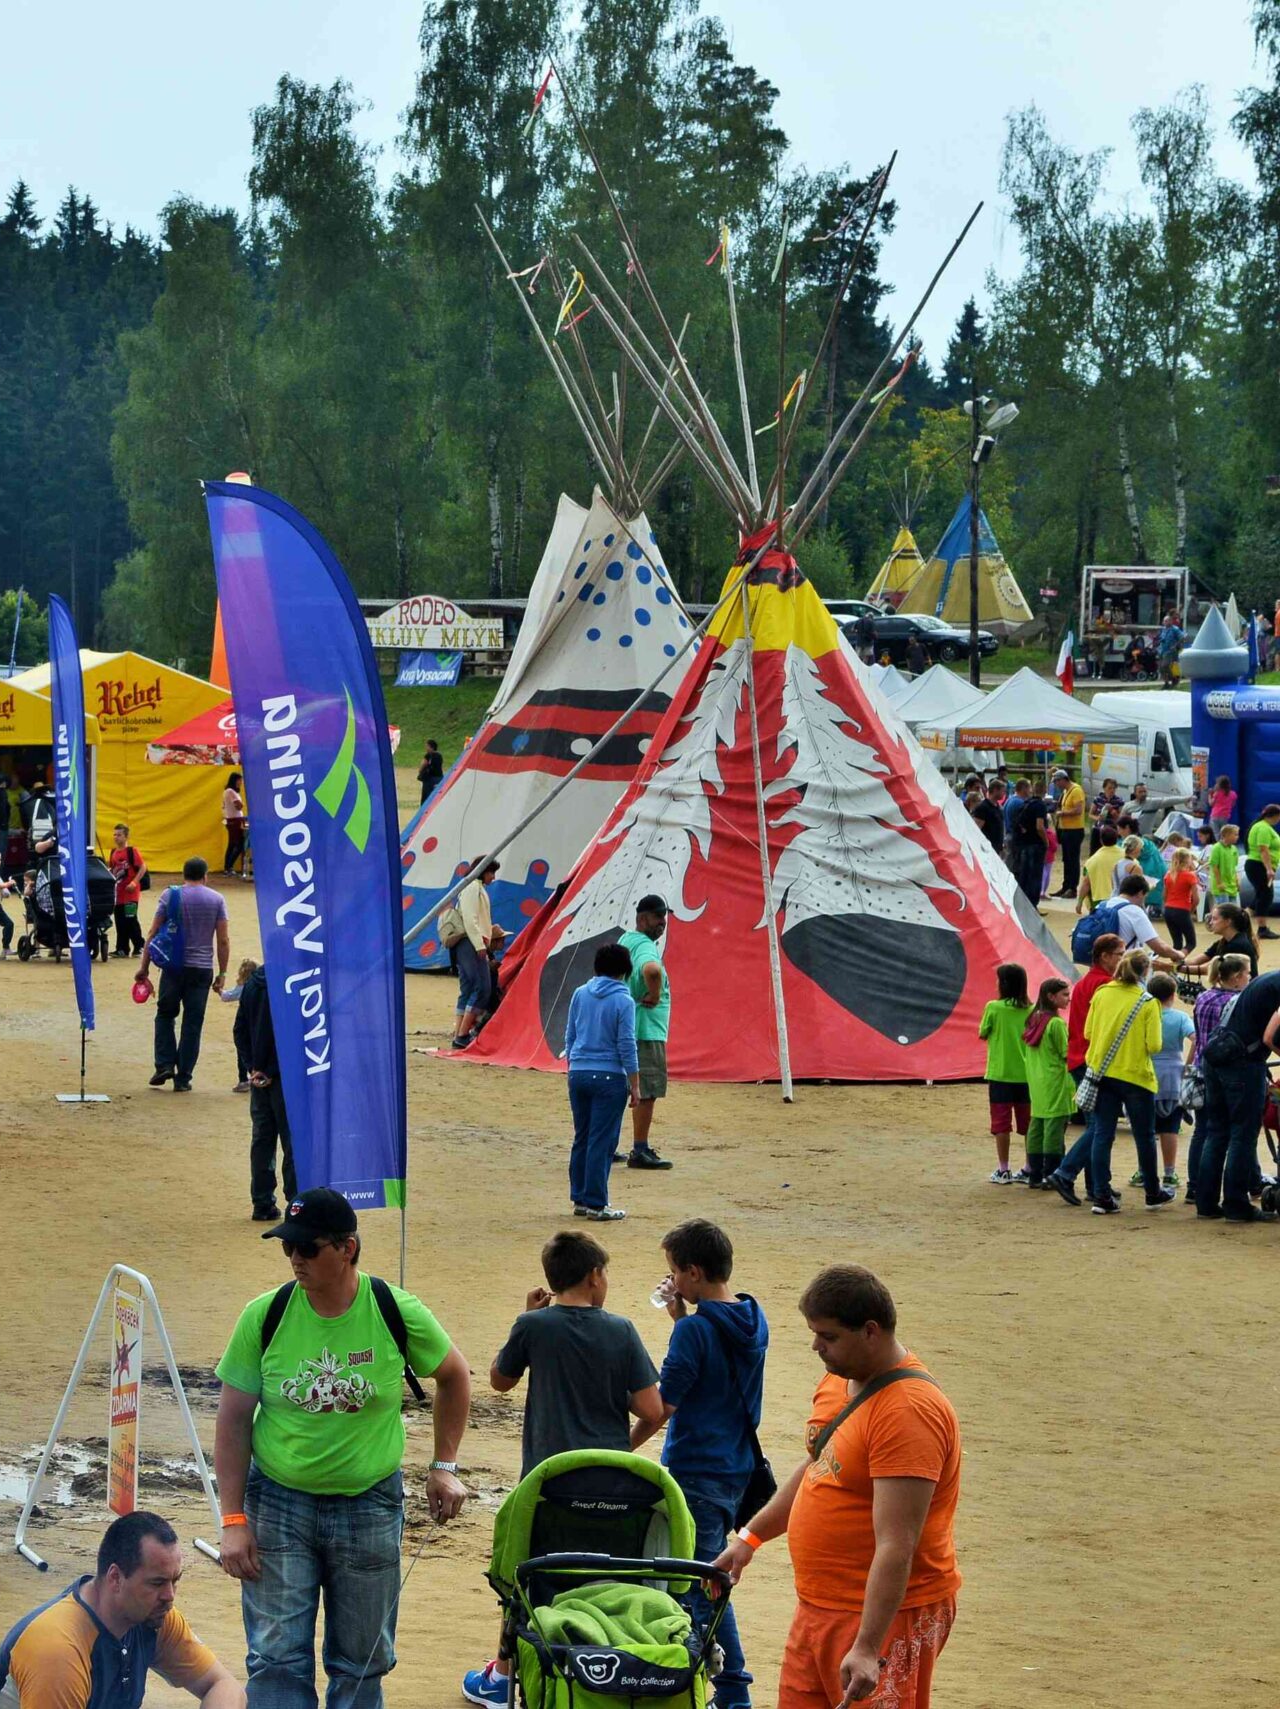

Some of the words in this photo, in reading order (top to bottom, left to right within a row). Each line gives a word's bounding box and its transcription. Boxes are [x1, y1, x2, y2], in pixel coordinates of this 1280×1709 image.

[398, 597, 455, 625] RODEO
[440, 624, 500, 648] MLÝN
[96, 677, 163, 723] Rebel
[962, 734, 1005, 745] Registrace
[1012, 736, 1051, 746] Informace
[348, 1348, 373, 1366] SQUASH
[571, 1500, 596, 1509] Sweet
[597, 1502, 629, 1510] Dreams
[621, 1676, 639, 1686] Baby
[640, 1677, 675, 1686] Collection
